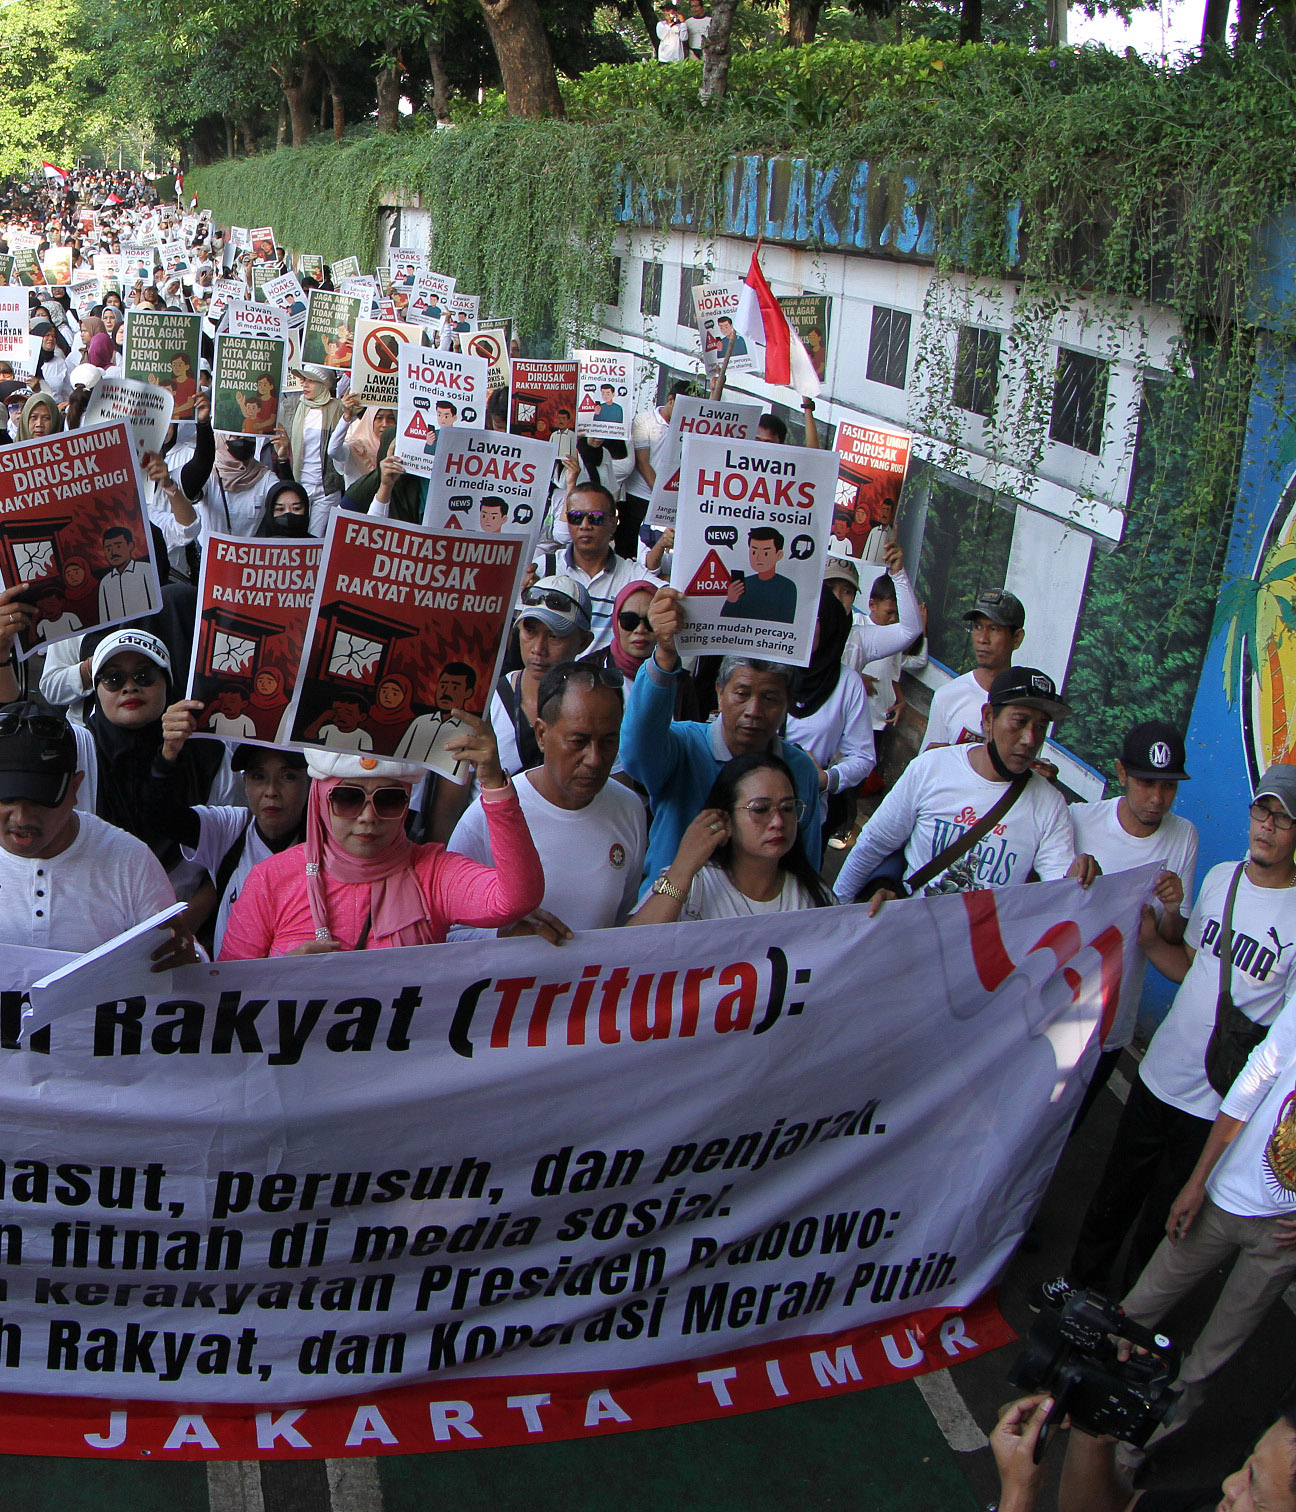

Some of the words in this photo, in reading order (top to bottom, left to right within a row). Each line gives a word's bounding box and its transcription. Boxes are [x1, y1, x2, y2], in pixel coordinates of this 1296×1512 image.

[132, 314, 159, 326] JAGA
[163, 316, 192, 327] ANAK
[132, 326, 156, 337] KITA
[158, 328, 184, 338] AGAR
[131, 350, 159, 360] DEMO
[132, 338, 162, 349] TIDAK
[164, 340, 187, 350] IKUT
[222, 338, 246, 348] JAGA
[250, 340, 276, 351] ANAK
[222, 348, 243, 359] KITA
[246, 350, 270, 360] AGAR
[130, 361, 172, 372] ANARKIS
[220, 369, 246, 380] DEMO
[222, 359, 249, 370] TIDAK
[252, 361, 272, 372] IKUT
[220, 380, 258, 392] ANARKIS
[66, 429, 120, 456] UMUM
[468, 438, 522, 458] Lawan
[842, 424, 884, 444] FASILITAS
[886, 436, 908, 450] UMUM
[839, 450, 868, 466] RAKYAT
[870, 458, 890, 470] YANG
[890, 462, 904, 474] RUGI
[852, 440, 898, 461] DIRUSAK
[12, 454, 100, 492] DIRUSAK
[445, 453, 536, 484] HOAKS
[726, 450, 796, 476] Lawan
[52, 480, 92, 500] YANG
[94, 468, 128, 490] RUGI
[446, 476, 457, 487] di
[459, 478, 494, 492] media
[498, 484, 532, 497] sosial
[697, 468, 816, 508] HOAKS
[700, 500, 714, 513] di
[718, 503, 765, 520] media
[769, 510, 812, 526] sosial
[344, 524, 447, 560] FASILITAS
[452, 543, 514, 566] UMUM
[708, 530, 735, 540] NEWS
[372, 554, 480, 590] DIRUSAK
[336, 574, 410, 603] RAKYAT
[414, 590, 460, 610] YANG
[462, 594, 503, 614] RUGI
[697, 580, 727, 590] HOAX
[680, 634, 708, 645] saring
[711, 635, 754, 646] sebelum
[756, 638, 794, 654] sharing
[684, 622, 714, 632] angan
[717, 622, 752, 633] mudah
[755, 627, 796, 642] percaya,
[93, 984, 421, 1066] Rakyat
[448, 946, 812, 1058] (Tritura):
[212, 1156, 505, 1219] perusuh,
[530, 1146, 644, 1197] dan
[50, 1219, 241, 1272] fitnah
[268, 1217, 330, 1269] di
[350, 1211, 542, 1264] media
[35, 1272, 396, 1315] kerakyatan
[416, 1246, 667, 1312] Presiden
[48, 1320, 272, 1382] Rakyat,
[297, 1328, 406, 1376] dan
[680, 1270, 836, 1334] Merah
[842, 1250, 957, 1306] Putih.
[84, 1388, 631, 1450] JAKARTA
[697, 1315, 980, 1407] TIMUR
